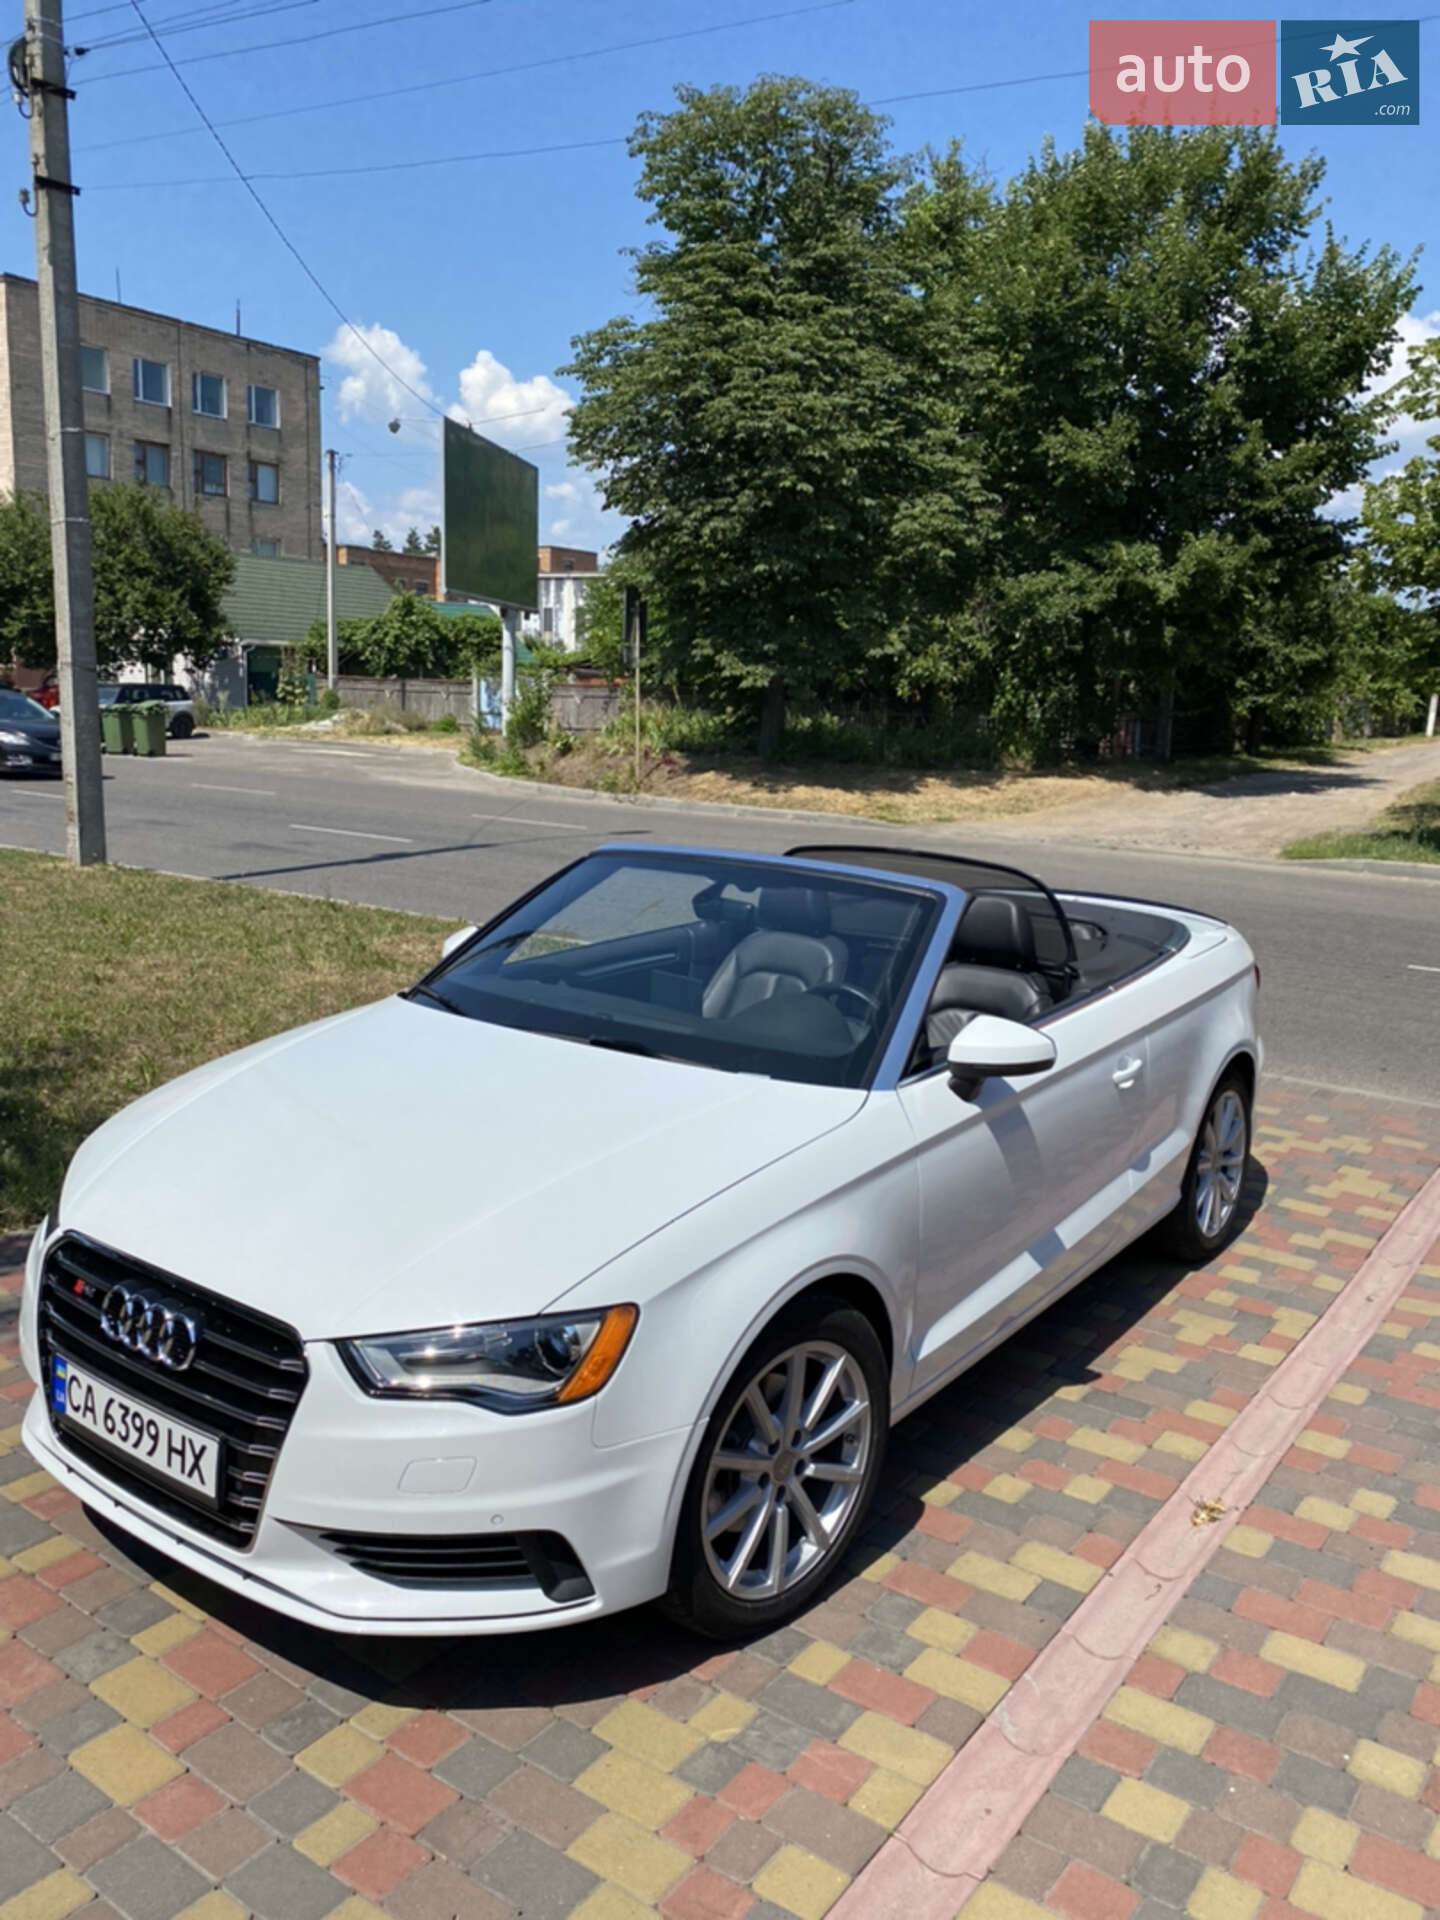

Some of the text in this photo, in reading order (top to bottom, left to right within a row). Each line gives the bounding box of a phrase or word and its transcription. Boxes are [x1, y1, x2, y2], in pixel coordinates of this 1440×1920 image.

[67, 1376, 208, 1486] CA 6399 HX
